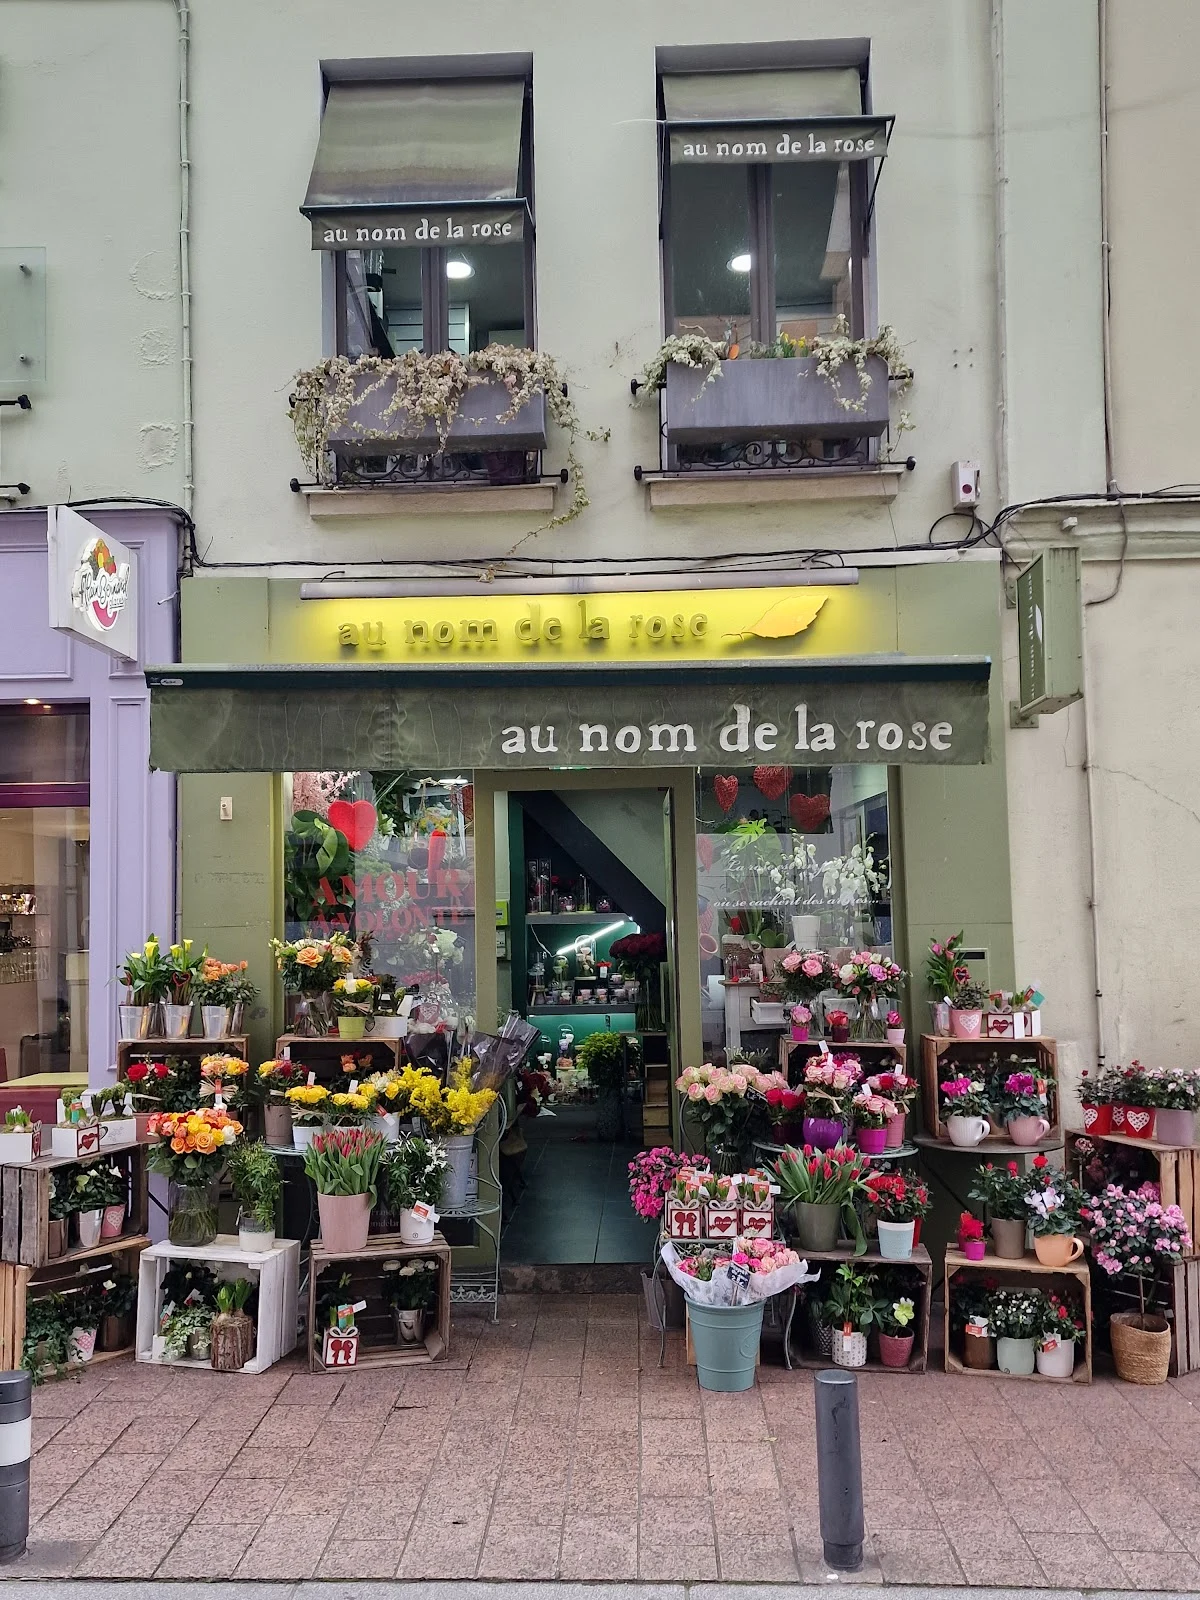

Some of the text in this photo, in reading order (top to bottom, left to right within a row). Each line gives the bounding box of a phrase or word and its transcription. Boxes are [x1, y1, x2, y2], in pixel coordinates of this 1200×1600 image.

[684, 132, 875, 156] au nom de la rose
[323, 217, 512, 243] au nom de la rose
[338, 599, 708, 646] au nom de la rose
[501, 703, 954, 754] au nom de la rose
[312, 869, 464, 906] AMOUR
[802, 893, 824, 905] des
